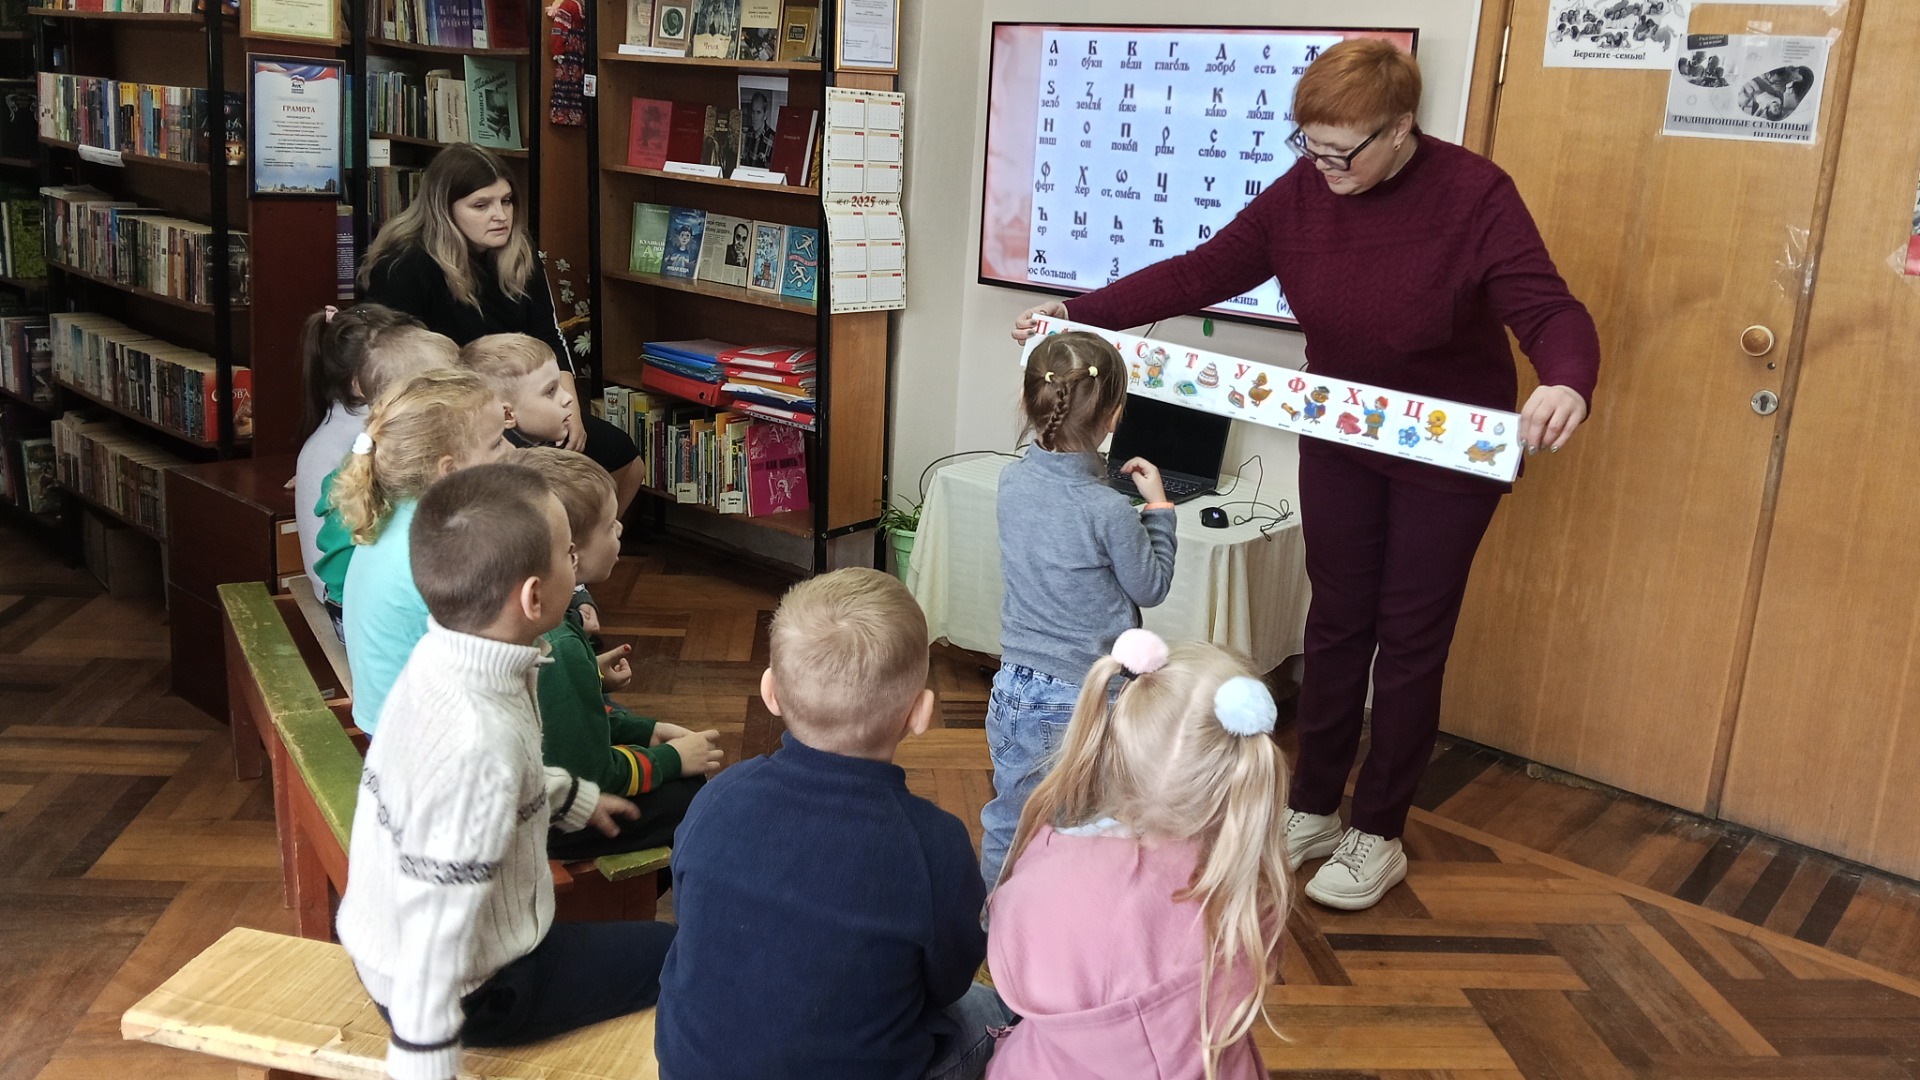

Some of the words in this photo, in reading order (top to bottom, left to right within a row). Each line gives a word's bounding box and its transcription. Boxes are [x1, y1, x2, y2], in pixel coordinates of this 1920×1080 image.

[1049, 39, 1059, 54] А
[1169, 42, 1178, 57] Г
[1215, 43, 1227, 61] Д
[1573, 50, 1610, 59] Берегите
[1253, 65, 1276, 74] есть
[1212, 87, 1223, 103] К
[282, 105, 316, 113] ГРАМОТА
[1673, 114, 1749, 127] ТРАДИЦИОННЫЕ
[1752, 120, 1811, 132] СЕМЕЙНЫЕ
[1039, 136, 1057, 145] наш
[1121, 122, 1131, 138] П
[1210, 129, 1218, 143] С
[1252, 131, 1265, 146] Т
[851, 195, 876, 208] 2025
[1199, 224, 1211, 239] Ю
[1040, 267, 1077, 281] большой
[1035, 319, 1049, 335] П
[1136, 341, 1150, 359] С
[1184, 352, 1198, 369] Т
[1234, 363, 1251, 380] У
[1288, 376, 1306, 394] Ф
[1343, 387, 1363, 406] Х
[1403, 399, 1424, 423] Ц
[1470, 412, 1487, 433] Ч
